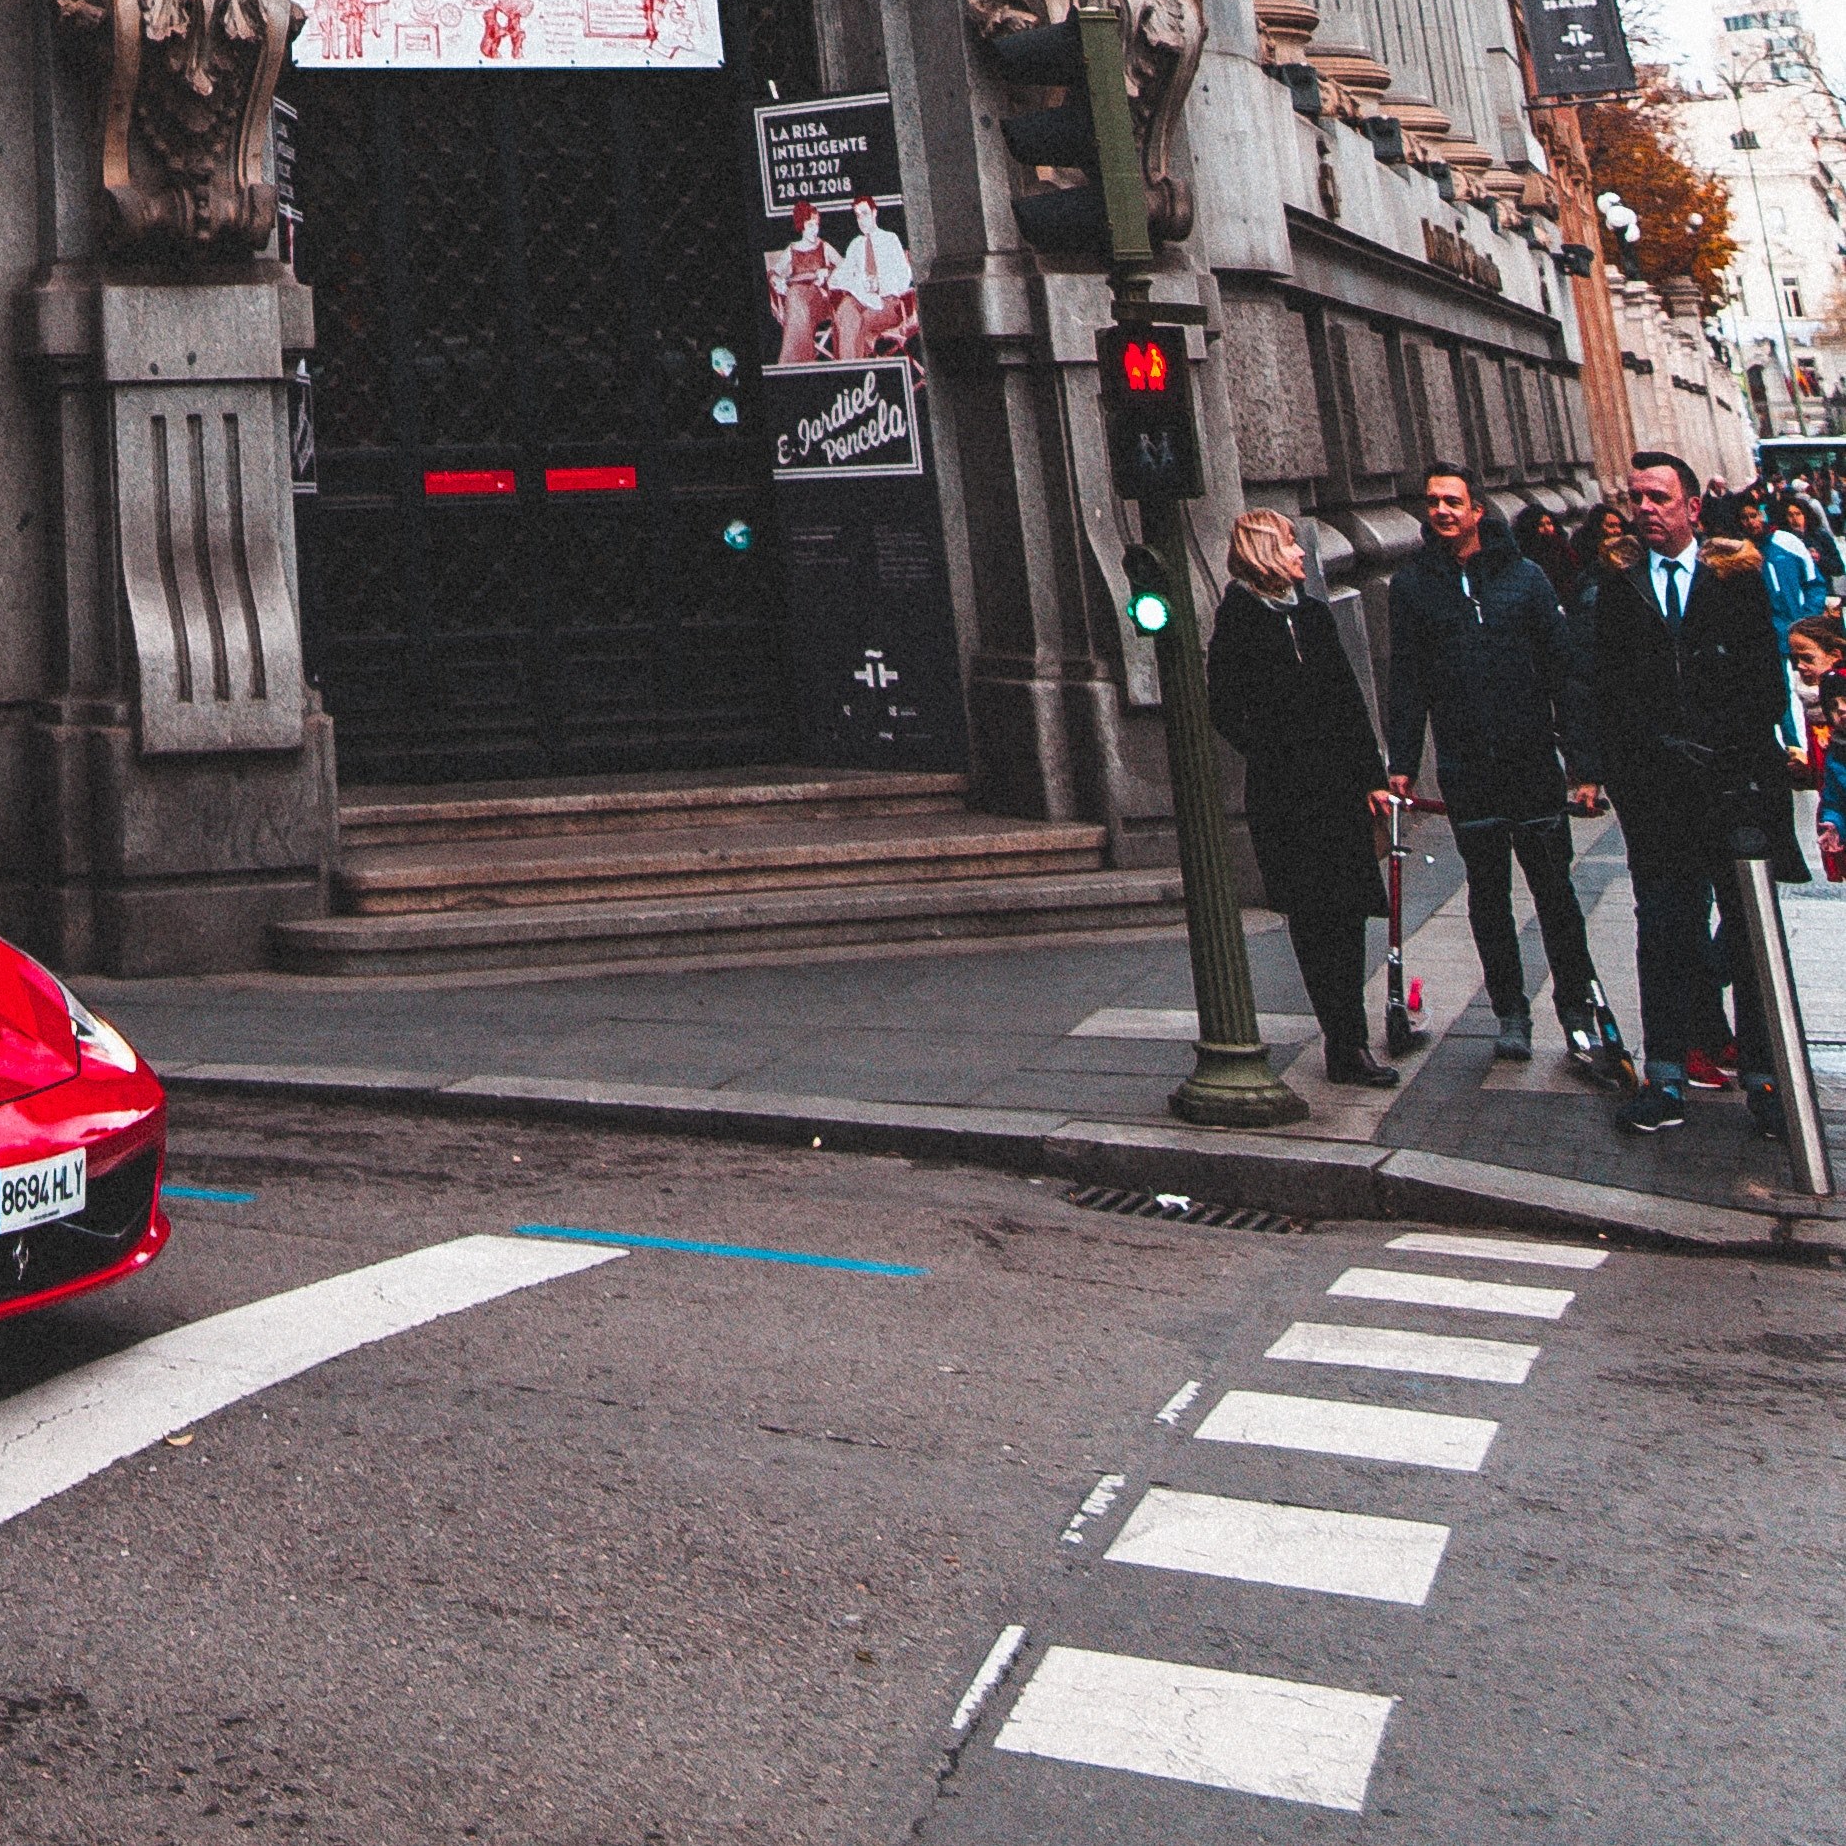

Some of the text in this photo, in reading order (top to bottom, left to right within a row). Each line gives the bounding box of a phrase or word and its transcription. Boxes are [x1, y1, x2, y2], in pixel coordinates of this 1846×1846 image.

[769, 121, 829, 142] LA RISA
[772, 135, 868, 160] INTELIGENTE
[774, 158, 841, 179] 19.12.2017
[777, 176, 853, 199] 28.01.2018
[797, 370, 879, 456] Jardiel
[820, 399, 907, 465] Poncela
[1, 1157, 84, 1216] 8694 HLY
